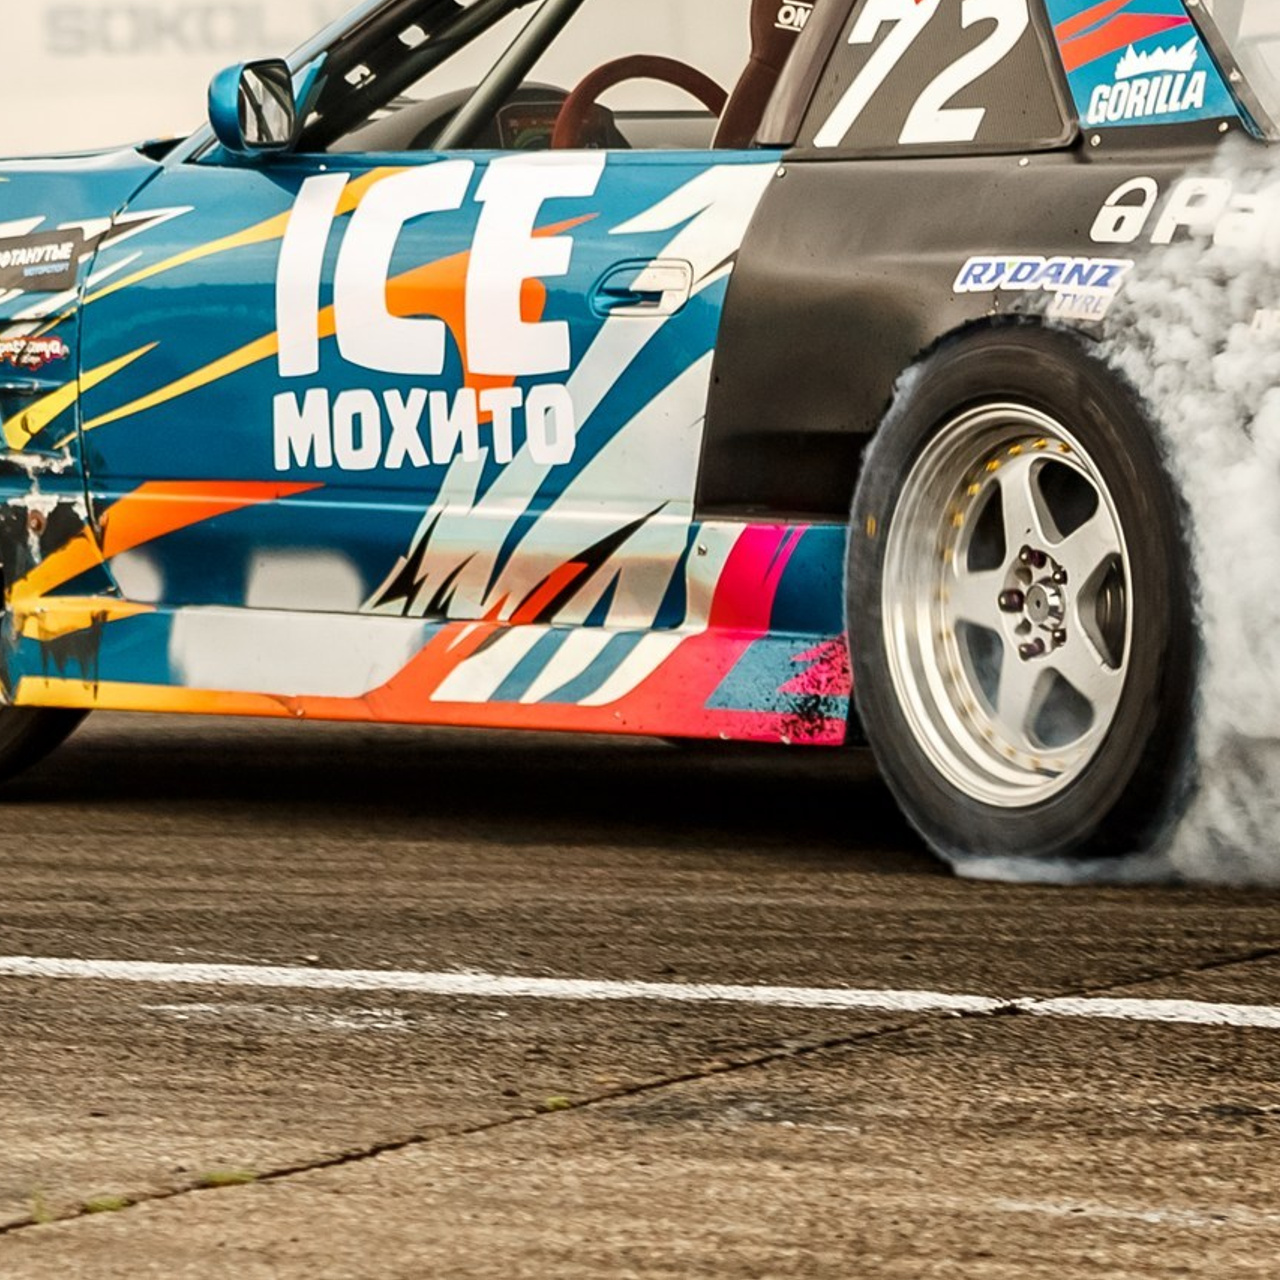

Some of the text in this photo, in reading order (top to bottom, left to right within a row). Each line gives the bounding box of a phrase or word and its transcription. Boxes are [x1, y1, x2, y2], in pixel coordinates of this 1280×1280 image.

[1086, 70, 1207, 125] GORILLA
[275, 153, 607, 377] ICE
[959, 261, 1127, 288] RYDANZ
[1055, 292, 1109, 315] TYRE
[273, 383, 577, 471] МОХИТО
